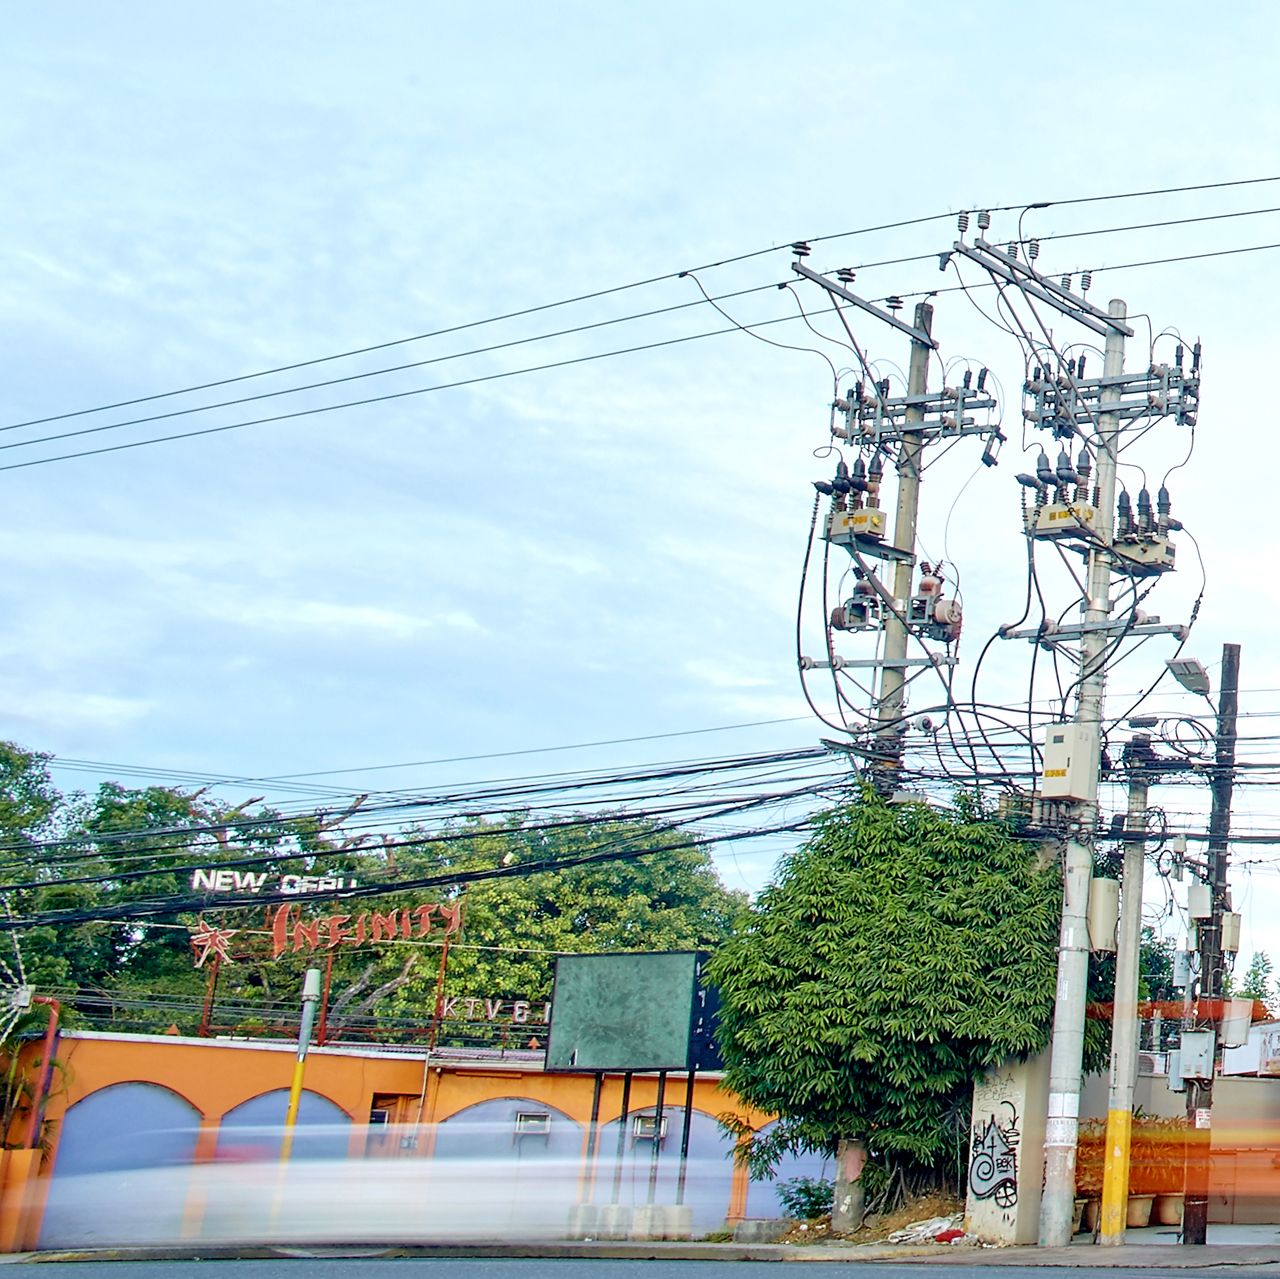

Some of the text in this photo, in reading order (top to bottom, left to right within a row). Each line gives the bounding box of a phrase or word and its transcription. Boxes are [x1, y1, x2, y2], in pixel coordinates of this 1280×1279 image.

[192, 869, 267, 892] NEW
[272, 902, 463, 961] INFINITY
[442, 997, 504, 1022] KTV
[512, 1000, 532, 1023] &
